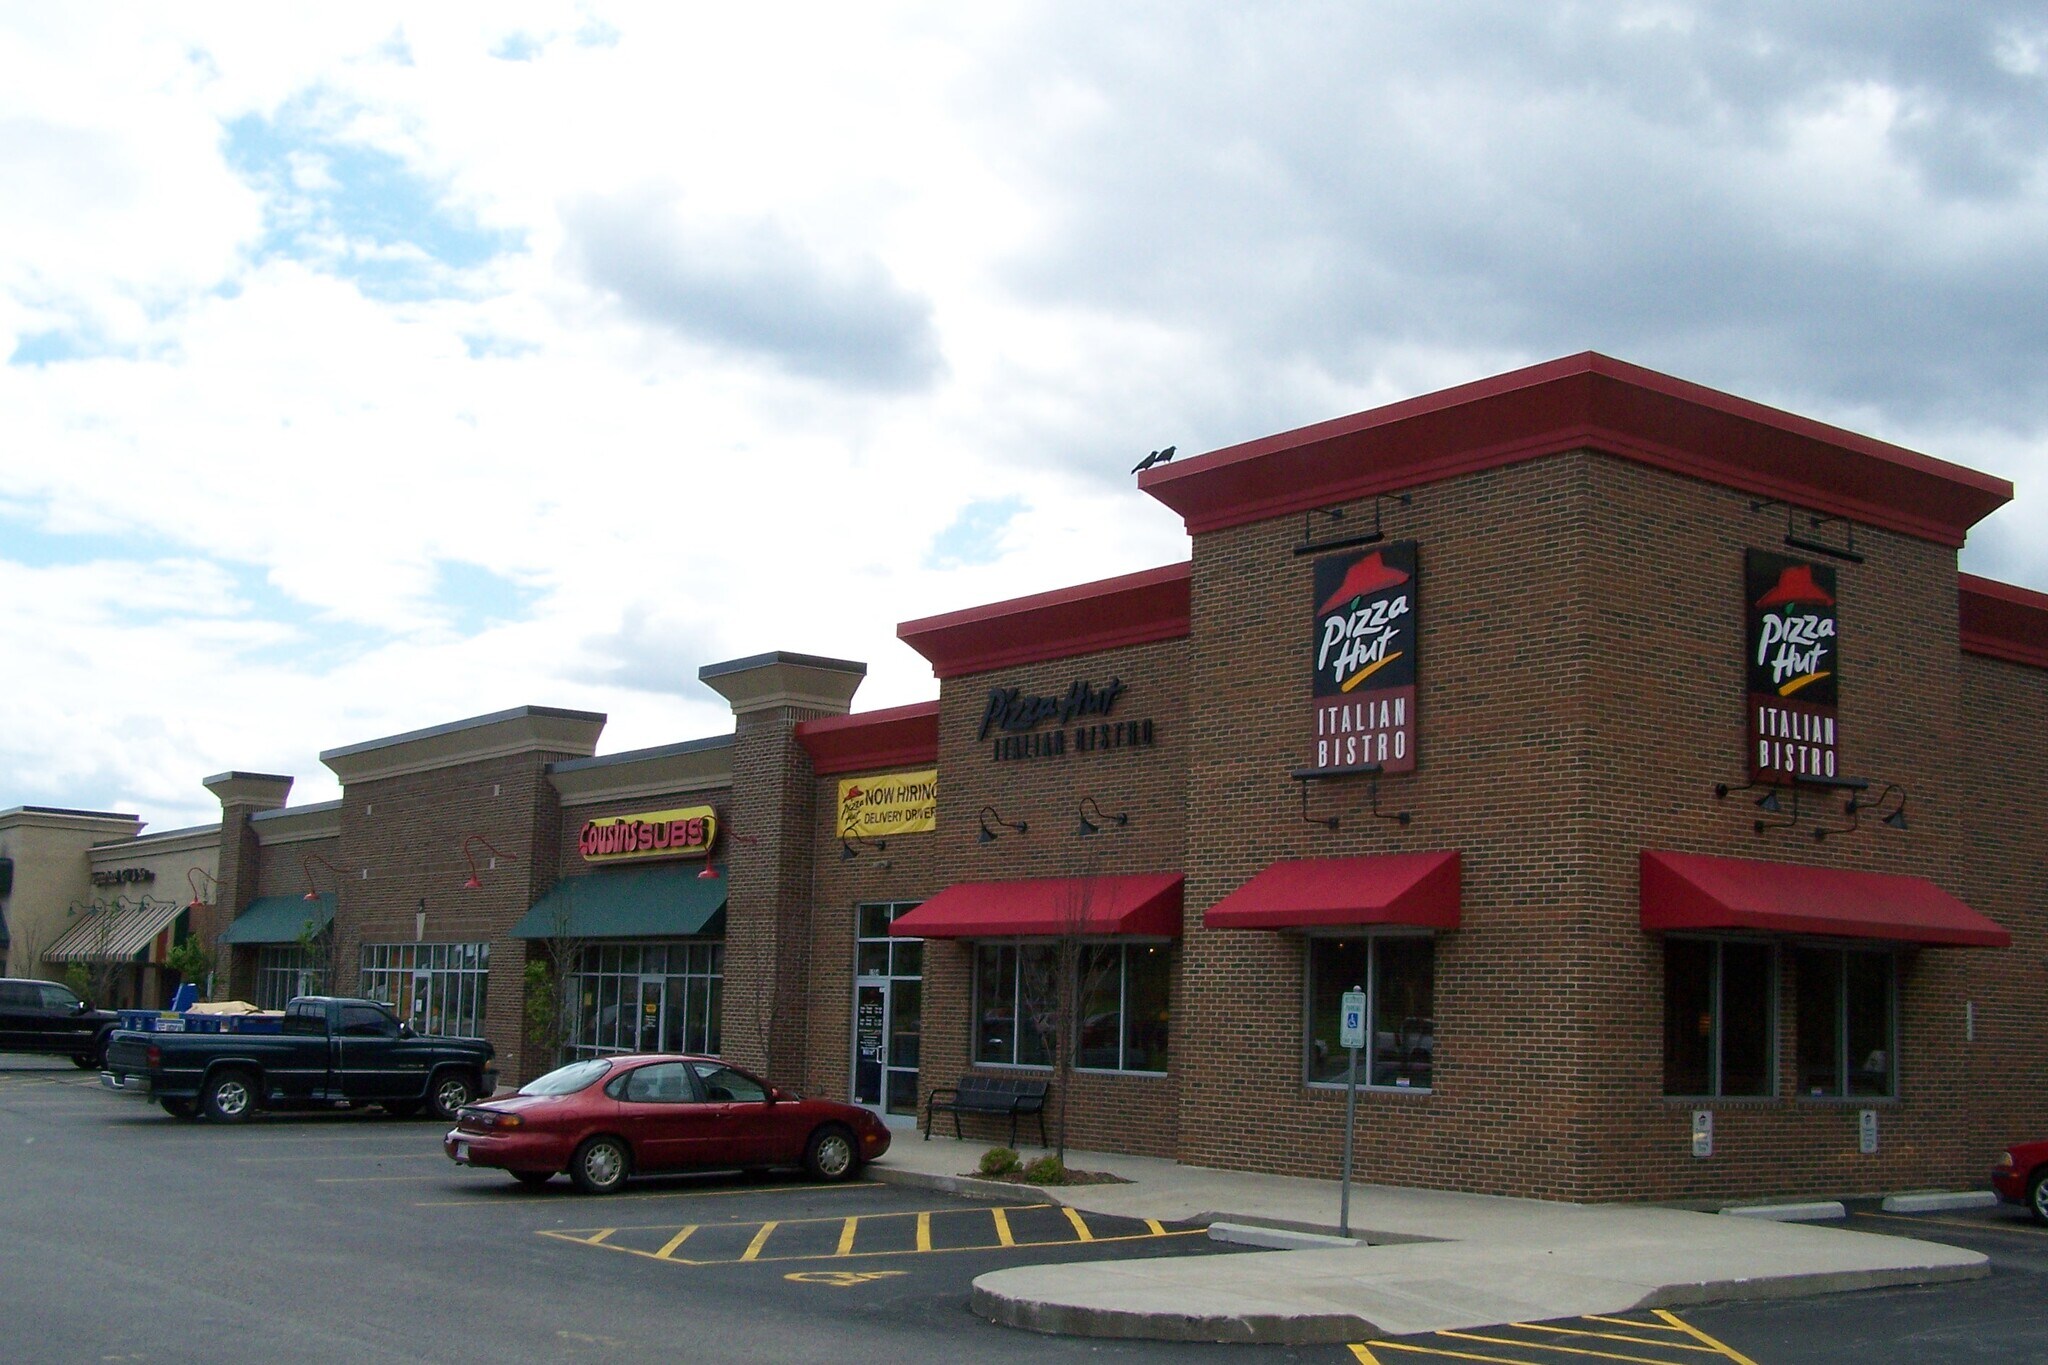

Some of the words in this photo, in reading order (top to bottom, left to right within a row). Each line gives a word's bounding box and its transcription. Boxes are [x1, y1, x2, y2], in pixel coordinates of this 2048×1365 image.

[1318, 595, 1409, 671] Pizza
[1757, 611, 1836, 666] Pizza
[1333, 626, 1400, 682] Hut
[1771, 643, 1828, 684] Hut
[977, 687, 1058, 742] Pizza
[1059, 676, 1128, 725] Hut
[1318, 698, 1406, 736] ITALIAN
[1759, 706, 1835, 746] ITALIAN
[993, 730, 1065, 762] ITALIAN
[1075, 718, 1153, 751] BISTRO
[1318, 731, 1406, 768] BISTRO
[1759, 740, 1835, 778] BISTRO
[865, 787, 895, 806] NOW
[578, 818, 638, 856] Cousins
[638, 817, 706, 850] SUBS
[864, 810, 903, 825] DELIVERY
